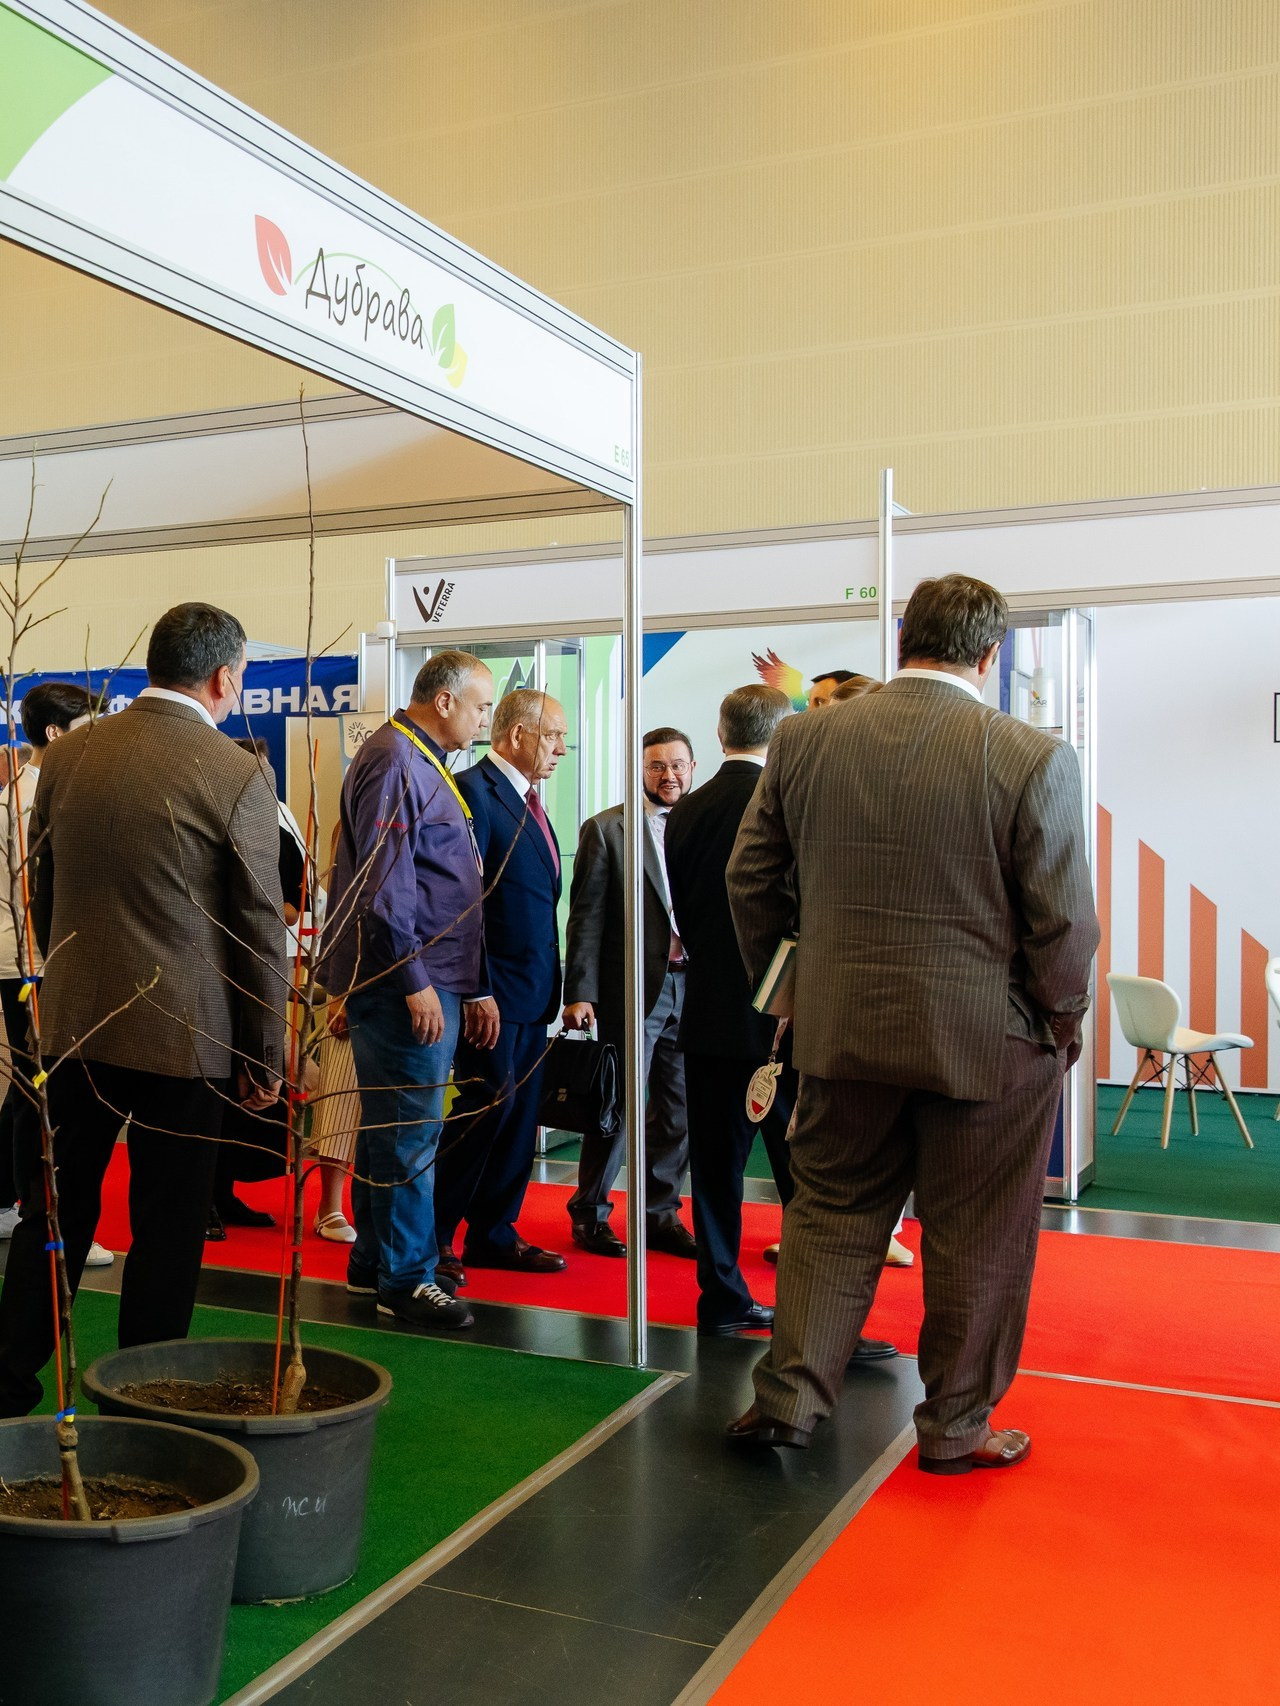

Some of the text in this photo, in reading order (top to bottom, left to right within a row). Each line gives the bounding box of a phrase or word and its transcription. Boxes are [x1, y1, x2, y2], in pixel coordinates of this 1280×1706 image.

[305, 247, 423, 350] Дубрава
[614, 445, 620, 463] E
[432, 582, 456, 623] VETERRA
[845, 586, 877, 600] F 60
